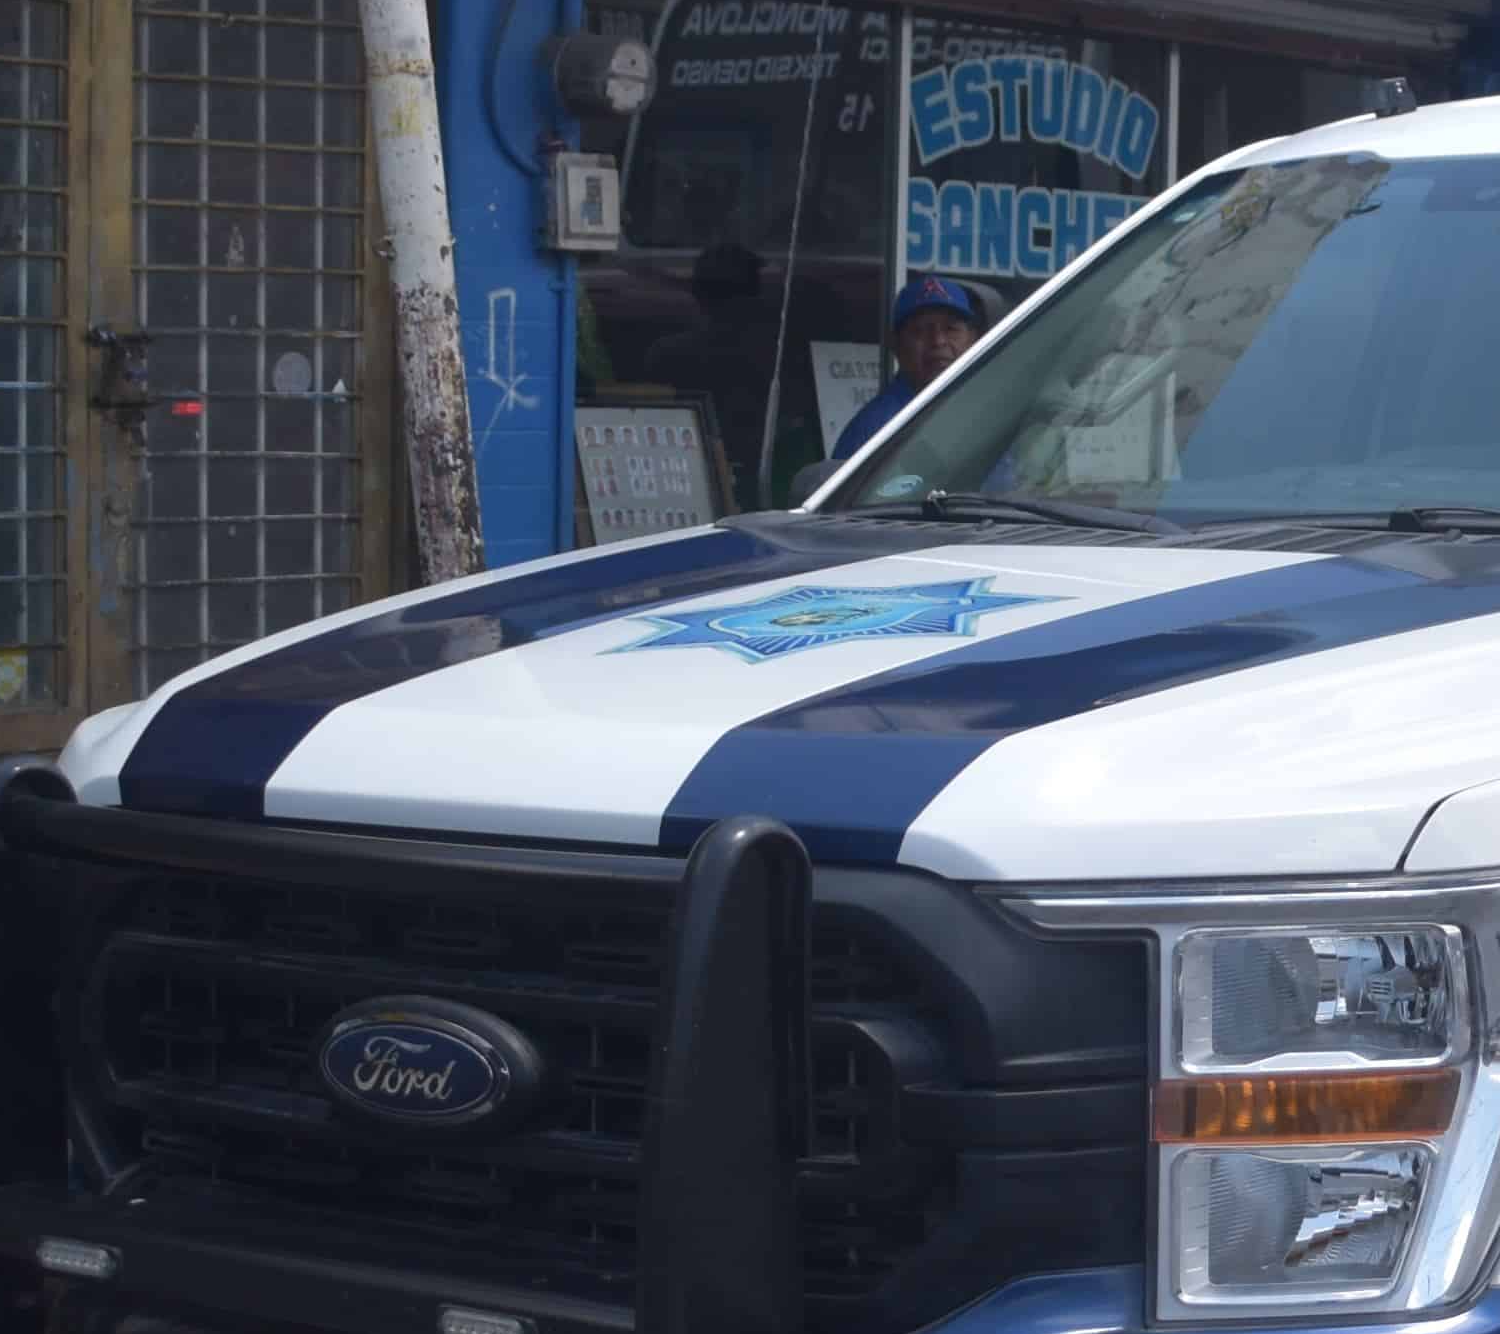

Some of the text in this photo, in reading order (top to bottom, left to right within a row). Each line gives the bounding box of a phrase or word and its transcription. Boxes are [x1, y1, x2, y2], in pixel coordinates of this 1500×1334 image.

[909, 58, 1159, 180] ESTUDIO
[908, 176, 1148, 278] SANCHE
[353, 1036, 456, 1100] Ford
